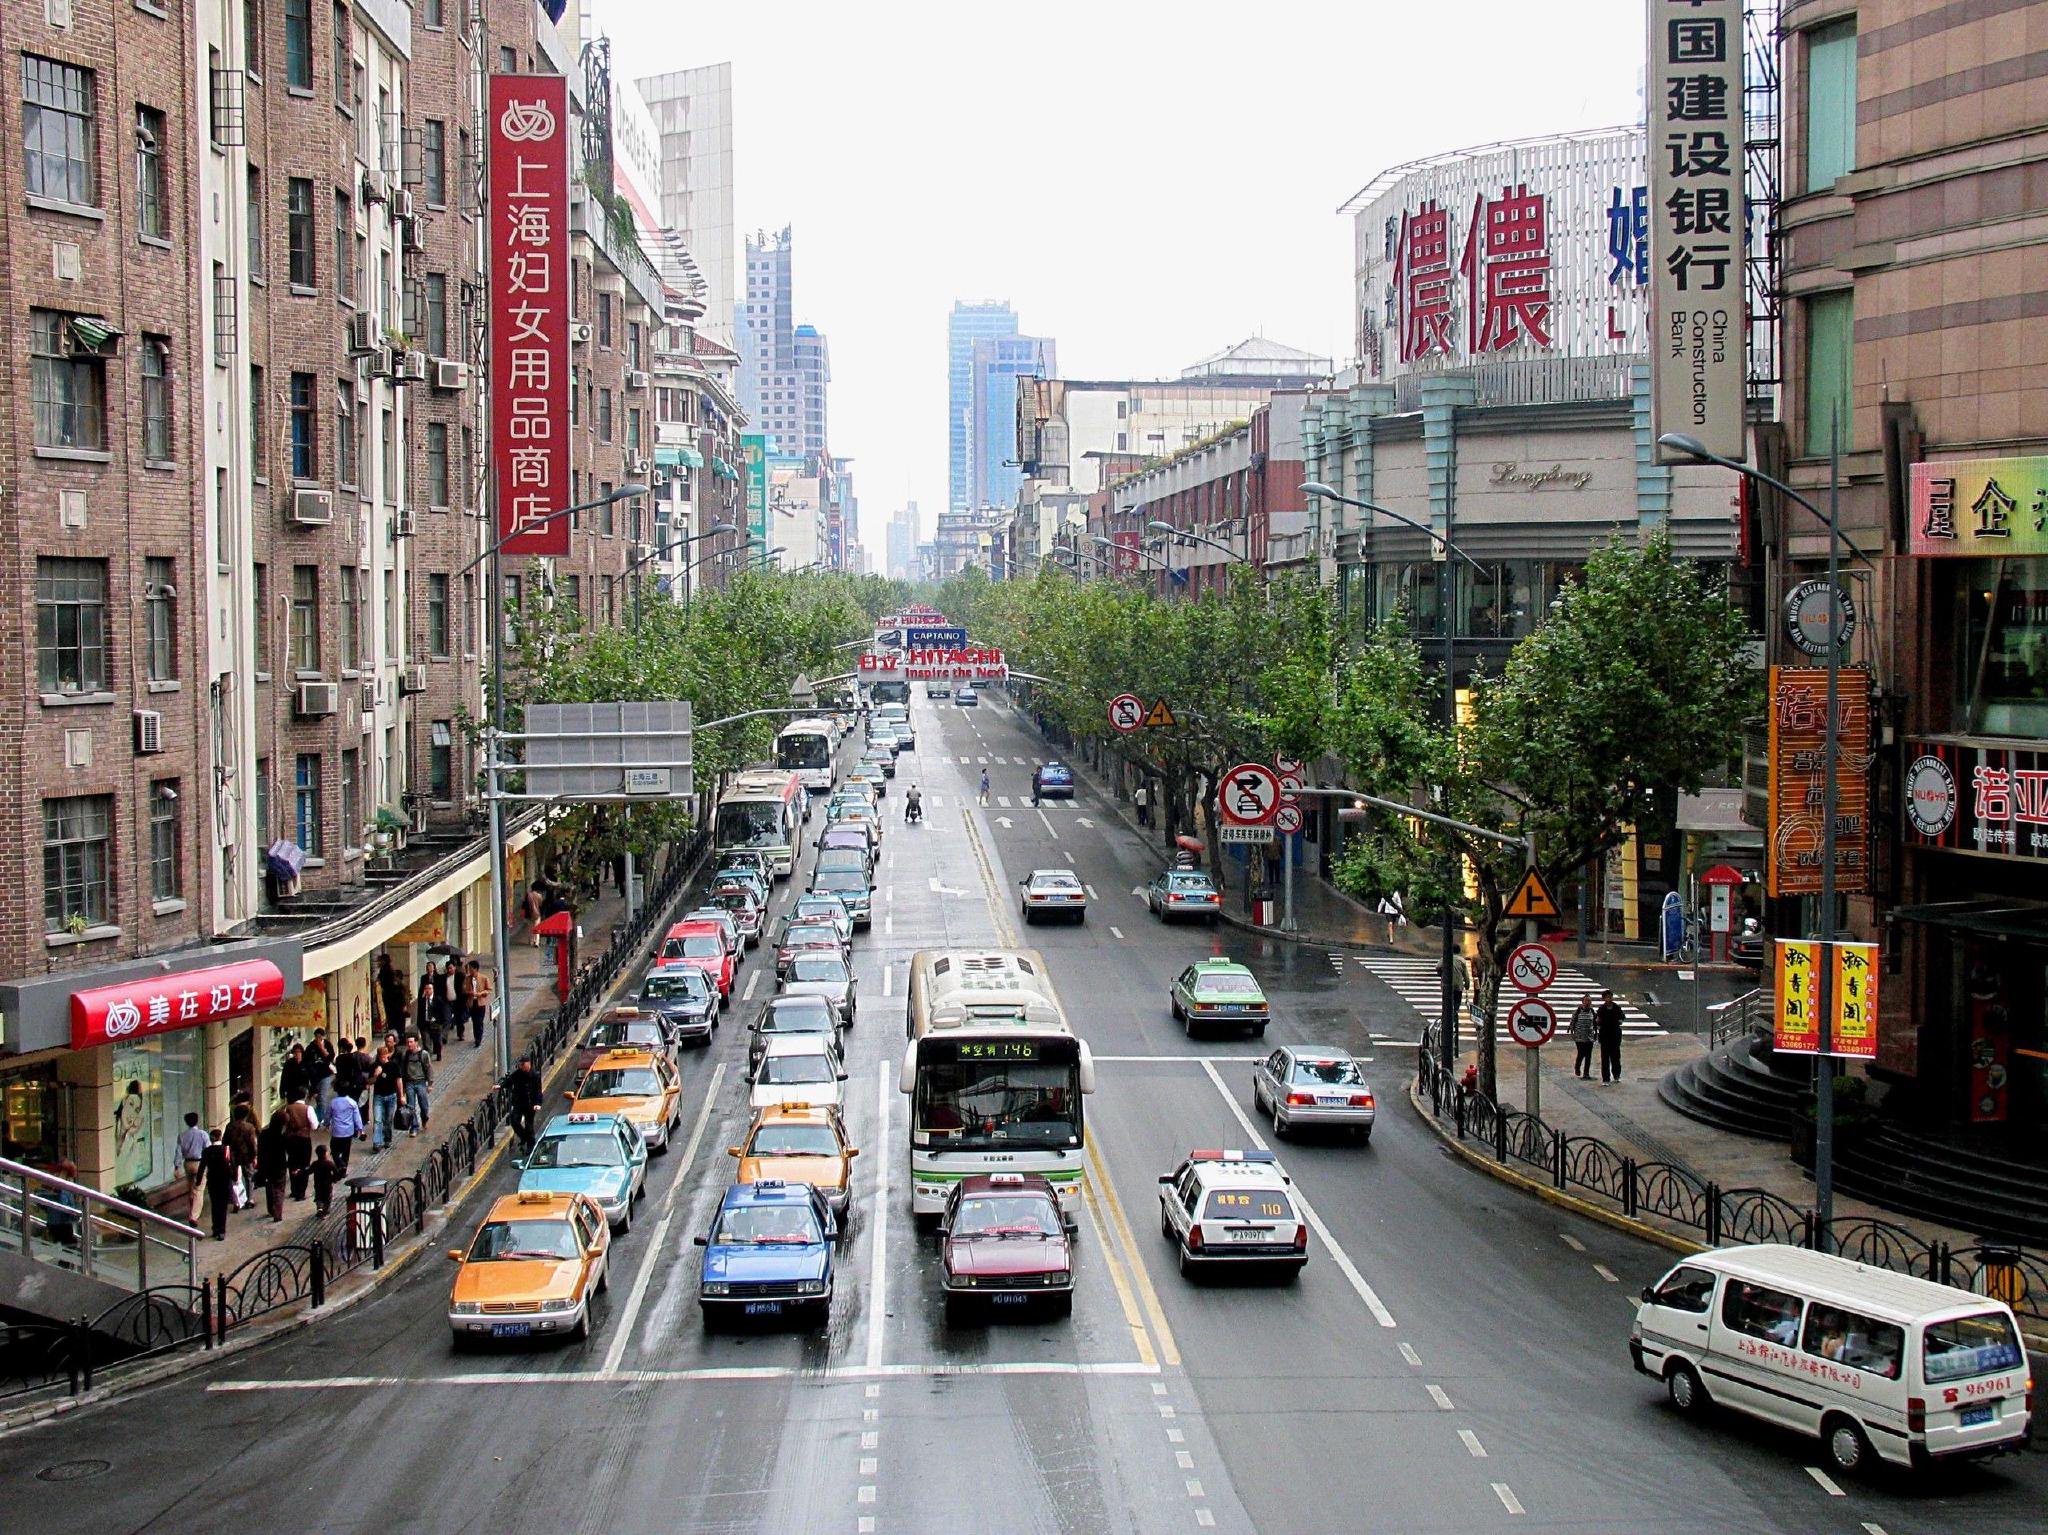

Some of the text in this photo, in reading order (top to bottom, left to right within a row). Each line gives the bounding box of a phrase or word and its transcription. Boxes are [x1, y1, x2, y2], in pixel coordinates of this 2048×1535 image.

[507, 155, 551, 535] 上海妇女用品商店
[1671, 310, 1687, 359] Bank
[1712, 309, 1728, 364] China
[1691, 309, 1706, 426] Construction
[913, 632, 960, 640] CAPTAINO
[904, 665, 1007, 679] Inspire the Next
[909, 647, 1001, 665] HITACHI
[1972, 766, 2048, 824] 诺亚
[147, 978, 259, 1027] 美在妇女
[1003, 1044, 1032, 1057] 146
[1261, 1203, 1282, 1216] 110
[1966, 1376, 2012, 1396] 96961
